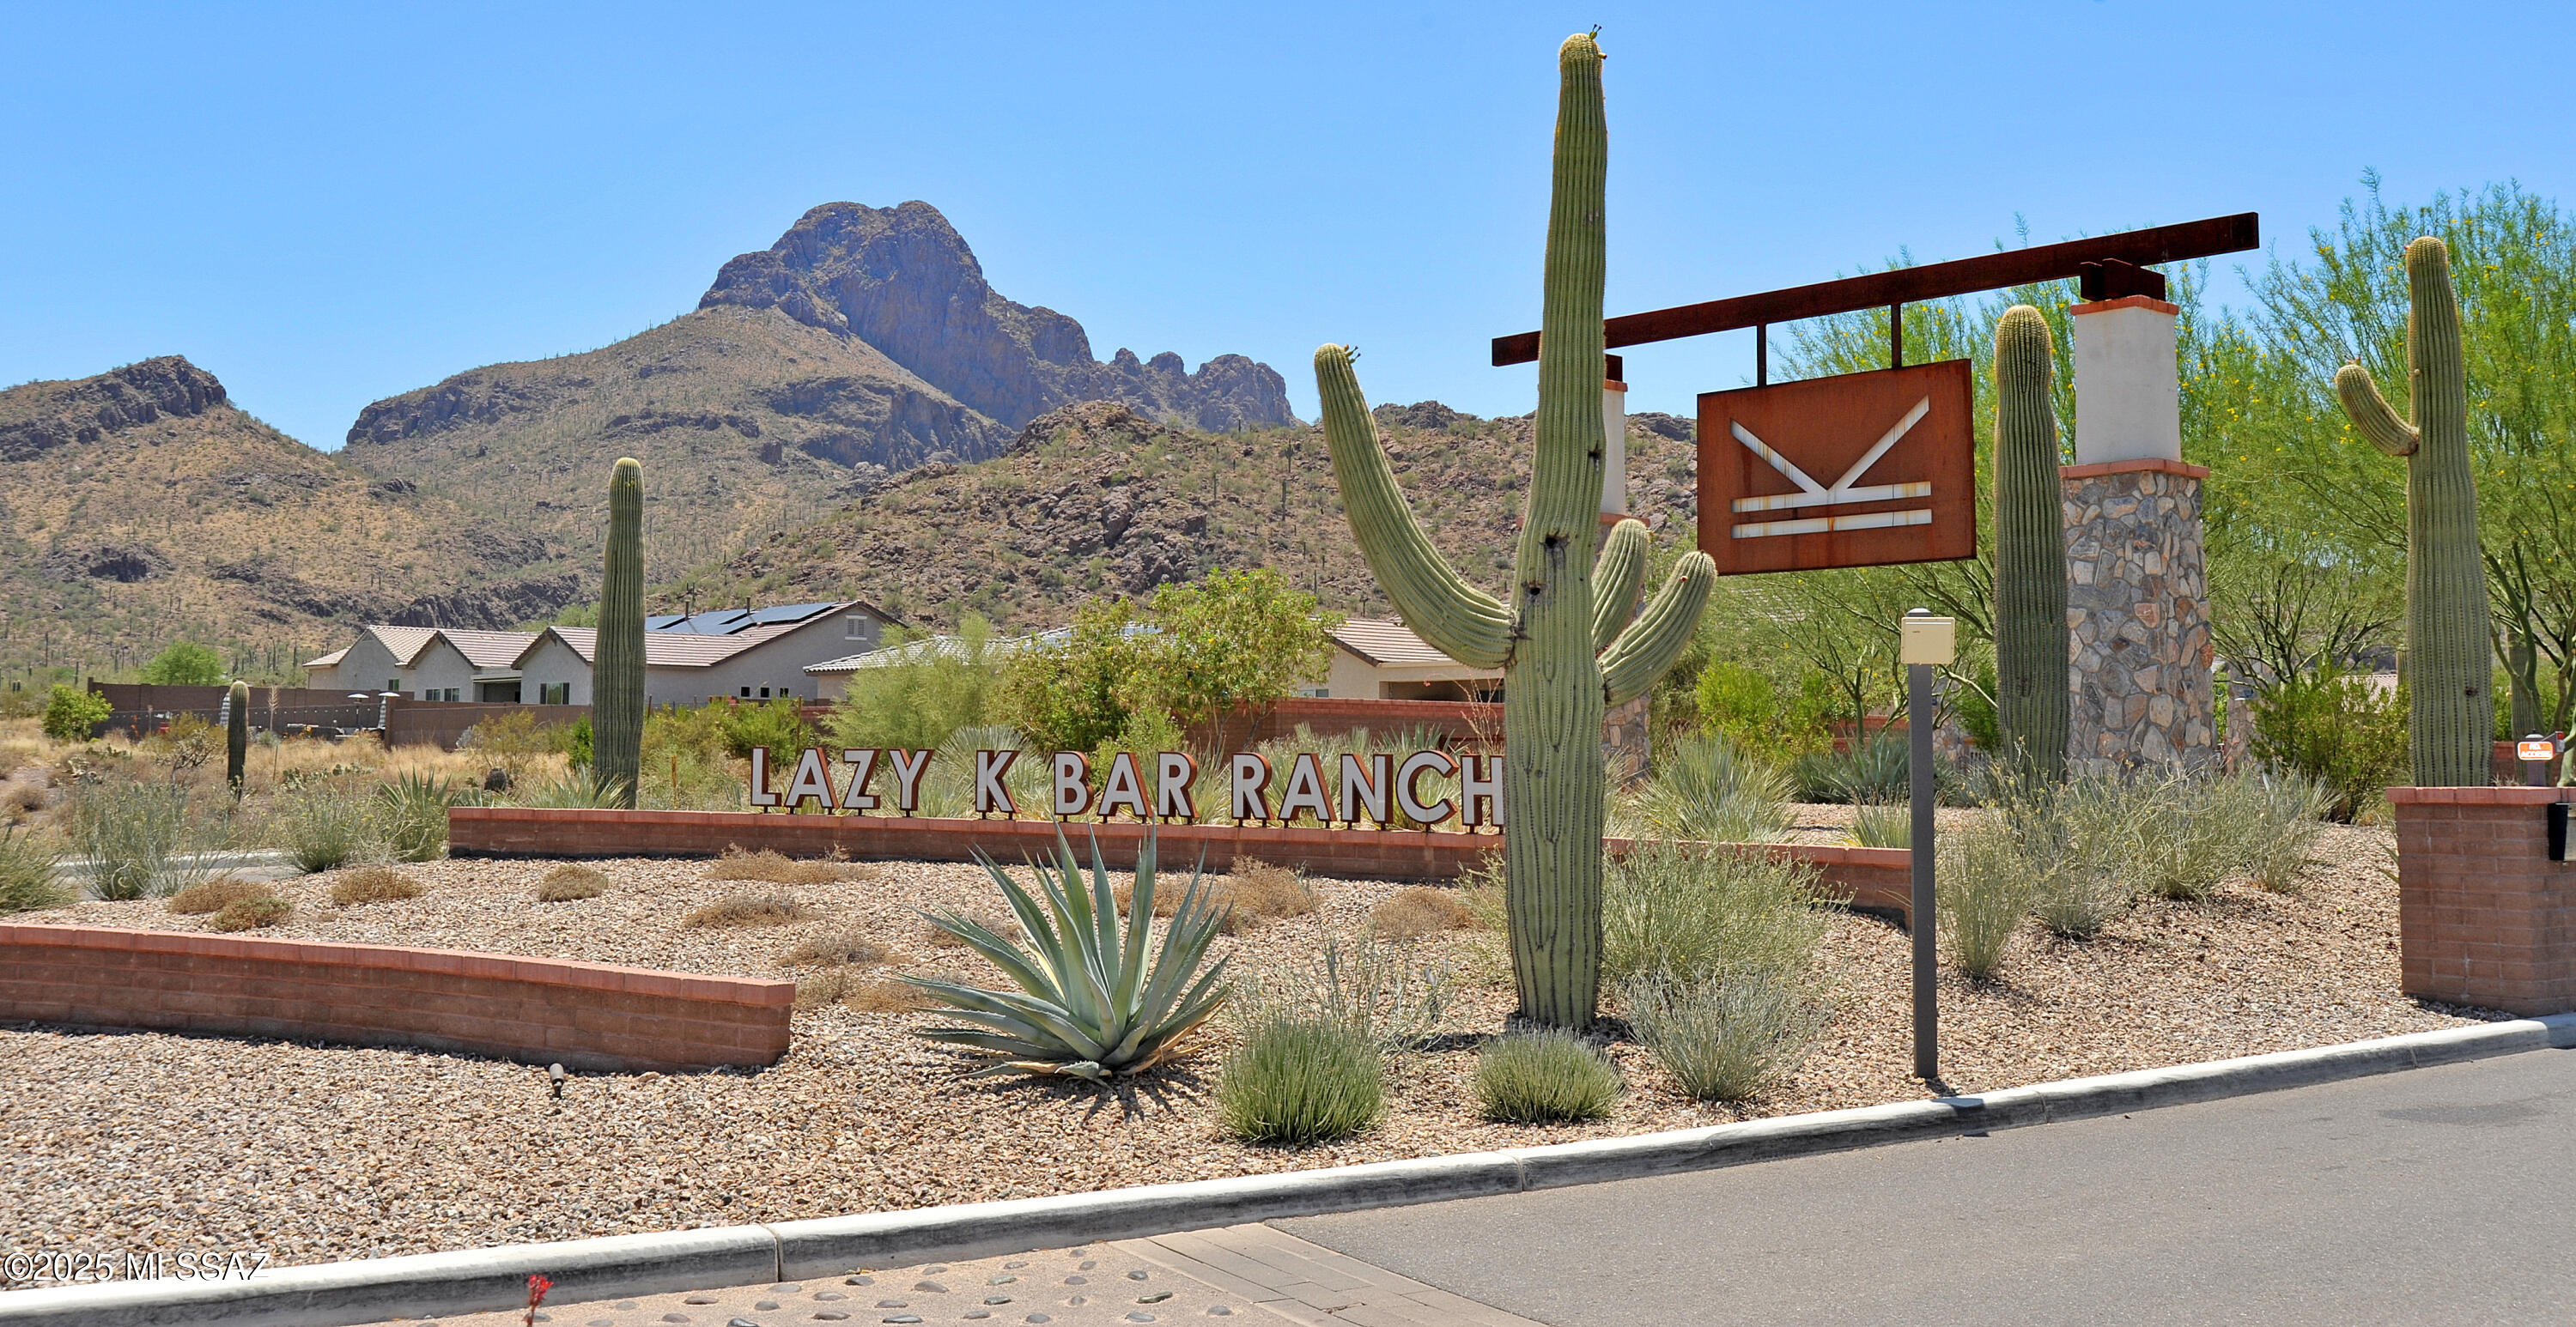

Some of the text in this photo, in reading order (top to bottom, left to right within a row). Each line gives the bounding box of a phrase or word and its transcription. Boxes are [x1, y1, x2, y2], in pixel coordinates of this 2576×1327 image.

[750, 746, 1505, 827] LAZY K BAR RANCH
